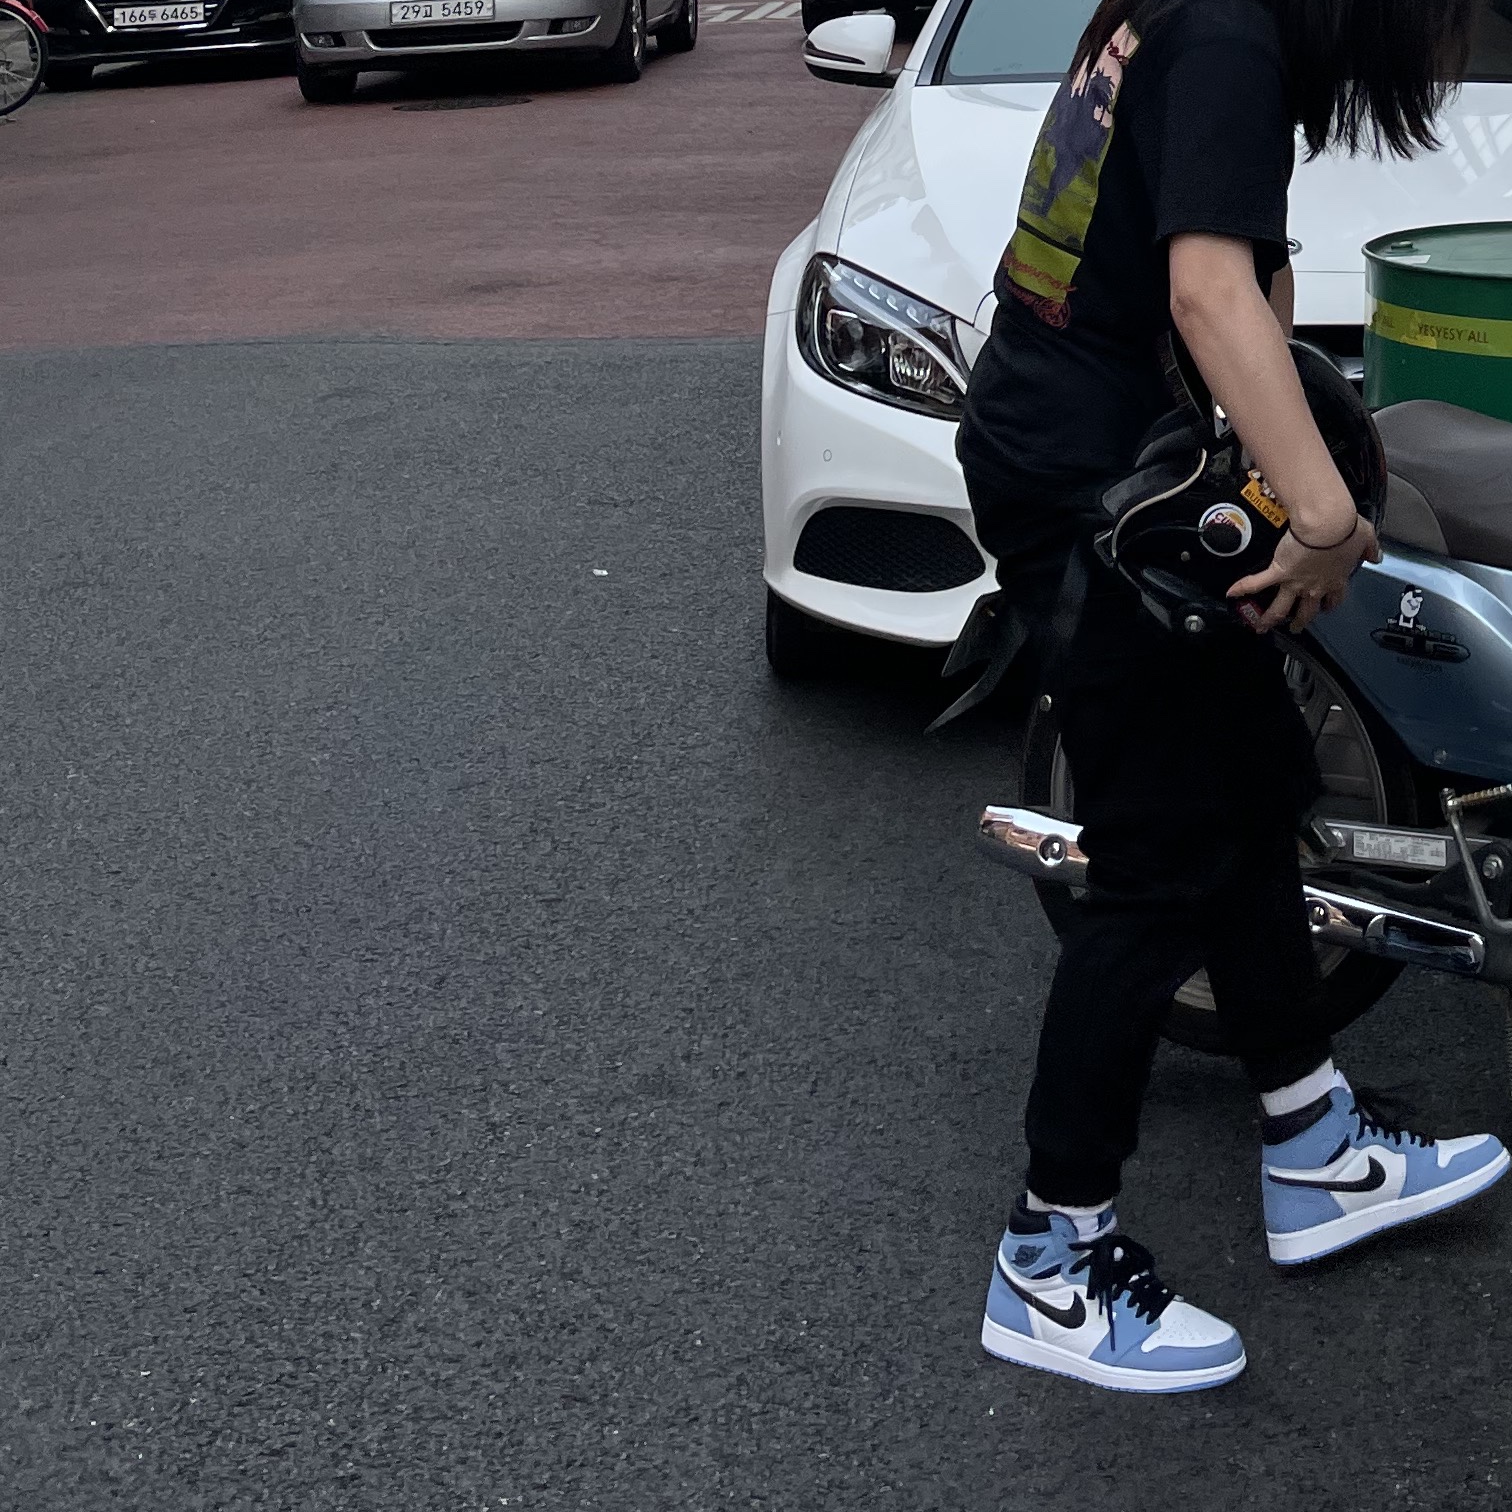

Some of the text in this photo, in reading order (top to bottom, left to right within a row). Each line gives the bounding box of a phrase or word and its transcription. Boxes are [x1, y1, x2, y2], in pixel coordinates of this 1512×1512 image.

[160, 5, 199, 21] 6465
[441, 0, 484, 18] 5459
[1243, 488, 1281, 525] BUILDER
